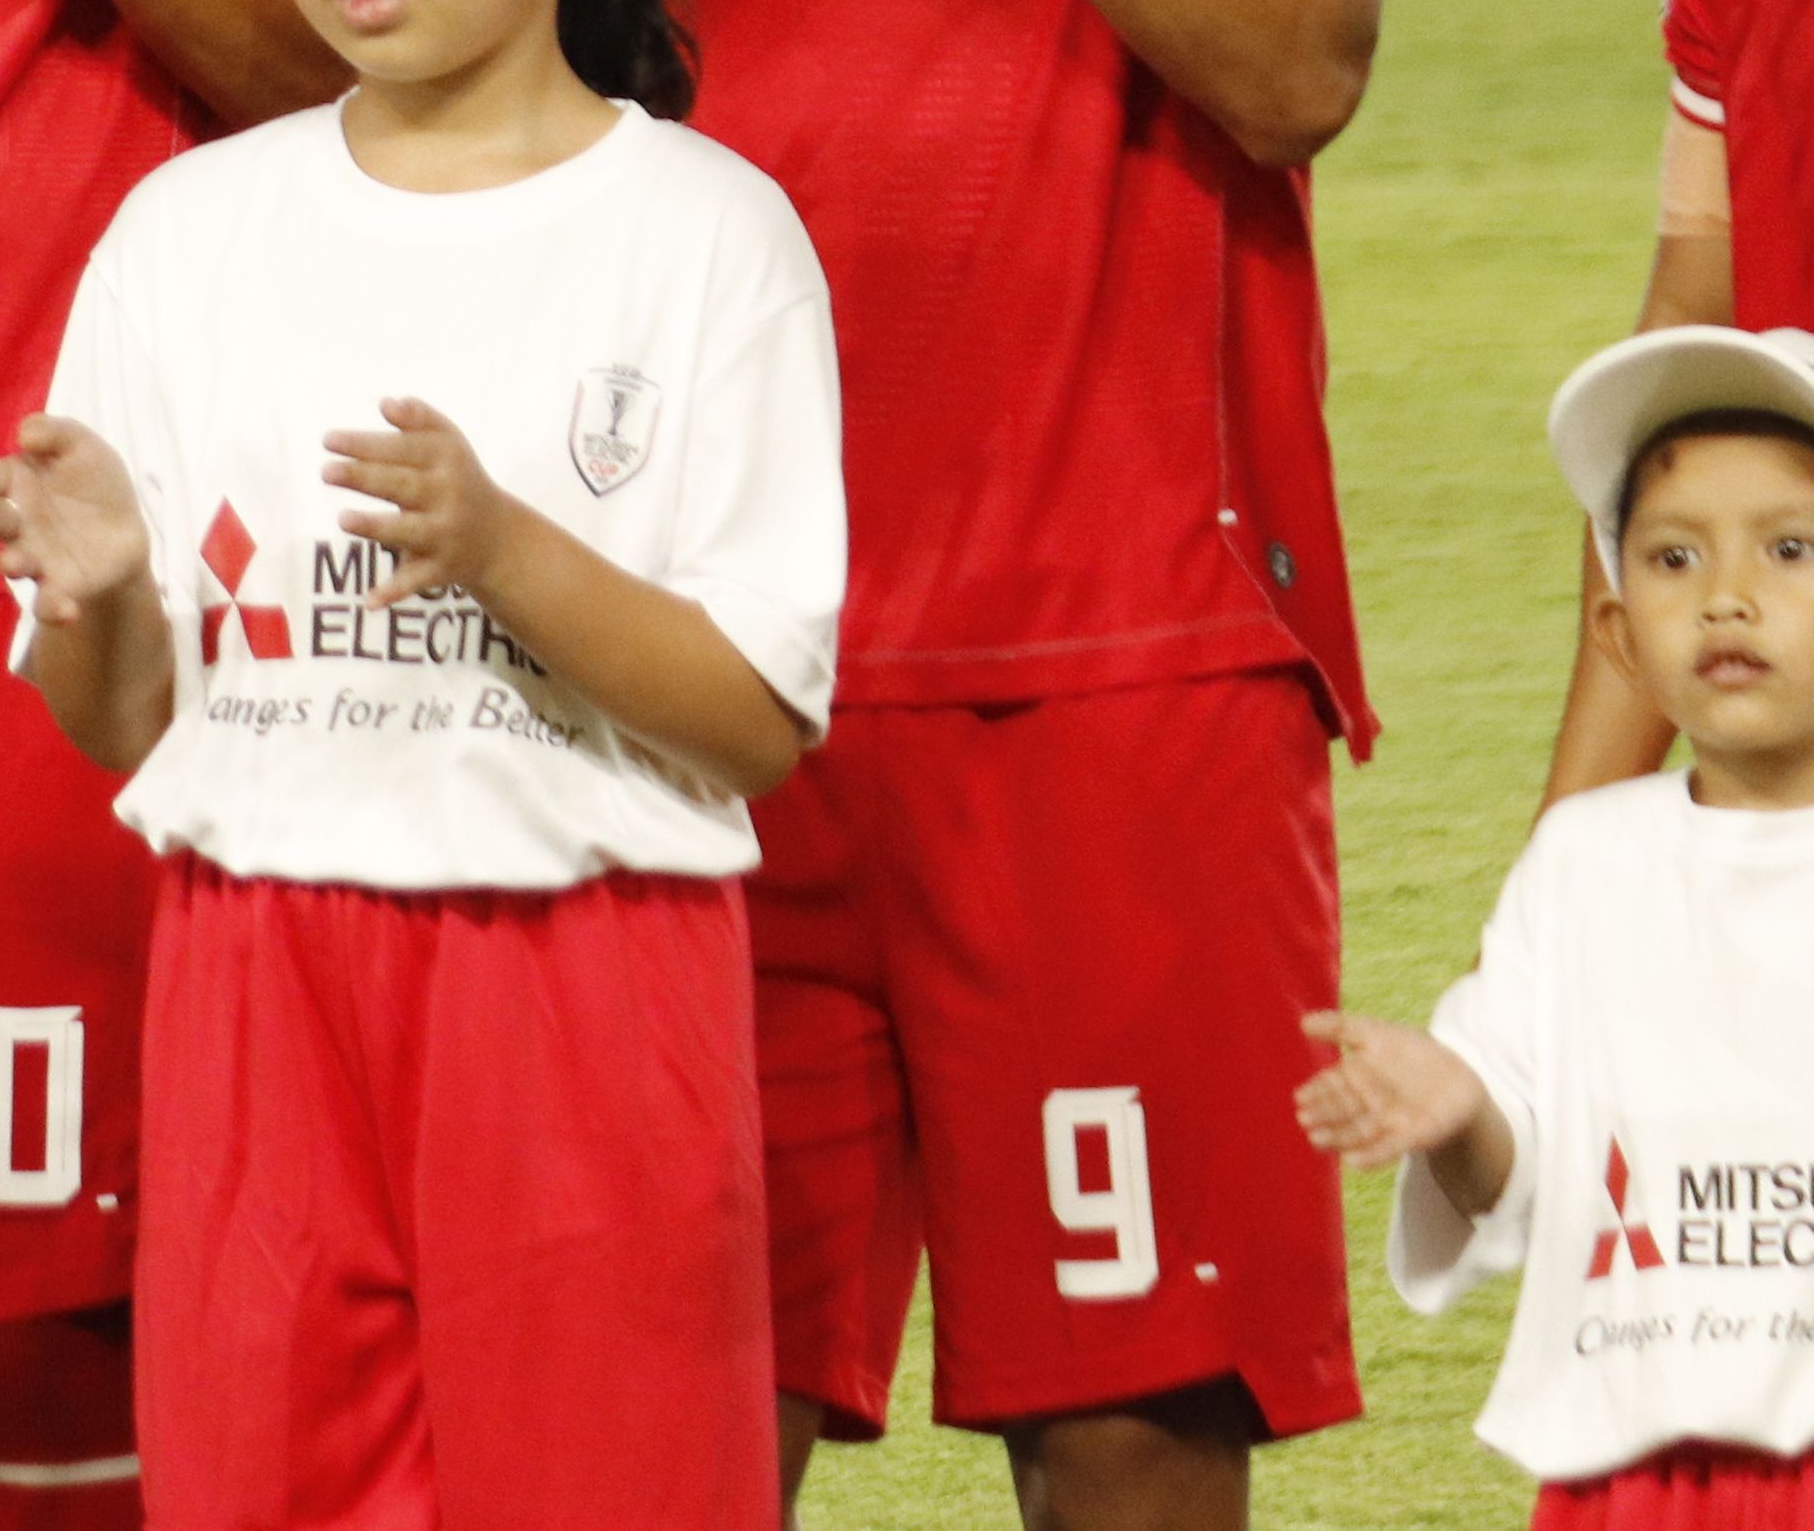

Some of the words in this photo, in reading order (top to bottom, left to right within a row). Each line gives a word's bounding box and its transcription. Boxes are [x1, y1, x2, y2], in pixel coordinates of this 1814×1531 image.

[327, 686, 398, 733] for
[1042, 1085, 1160, 1302] 9
[1676, 1160, 1814, 1212] MITS
